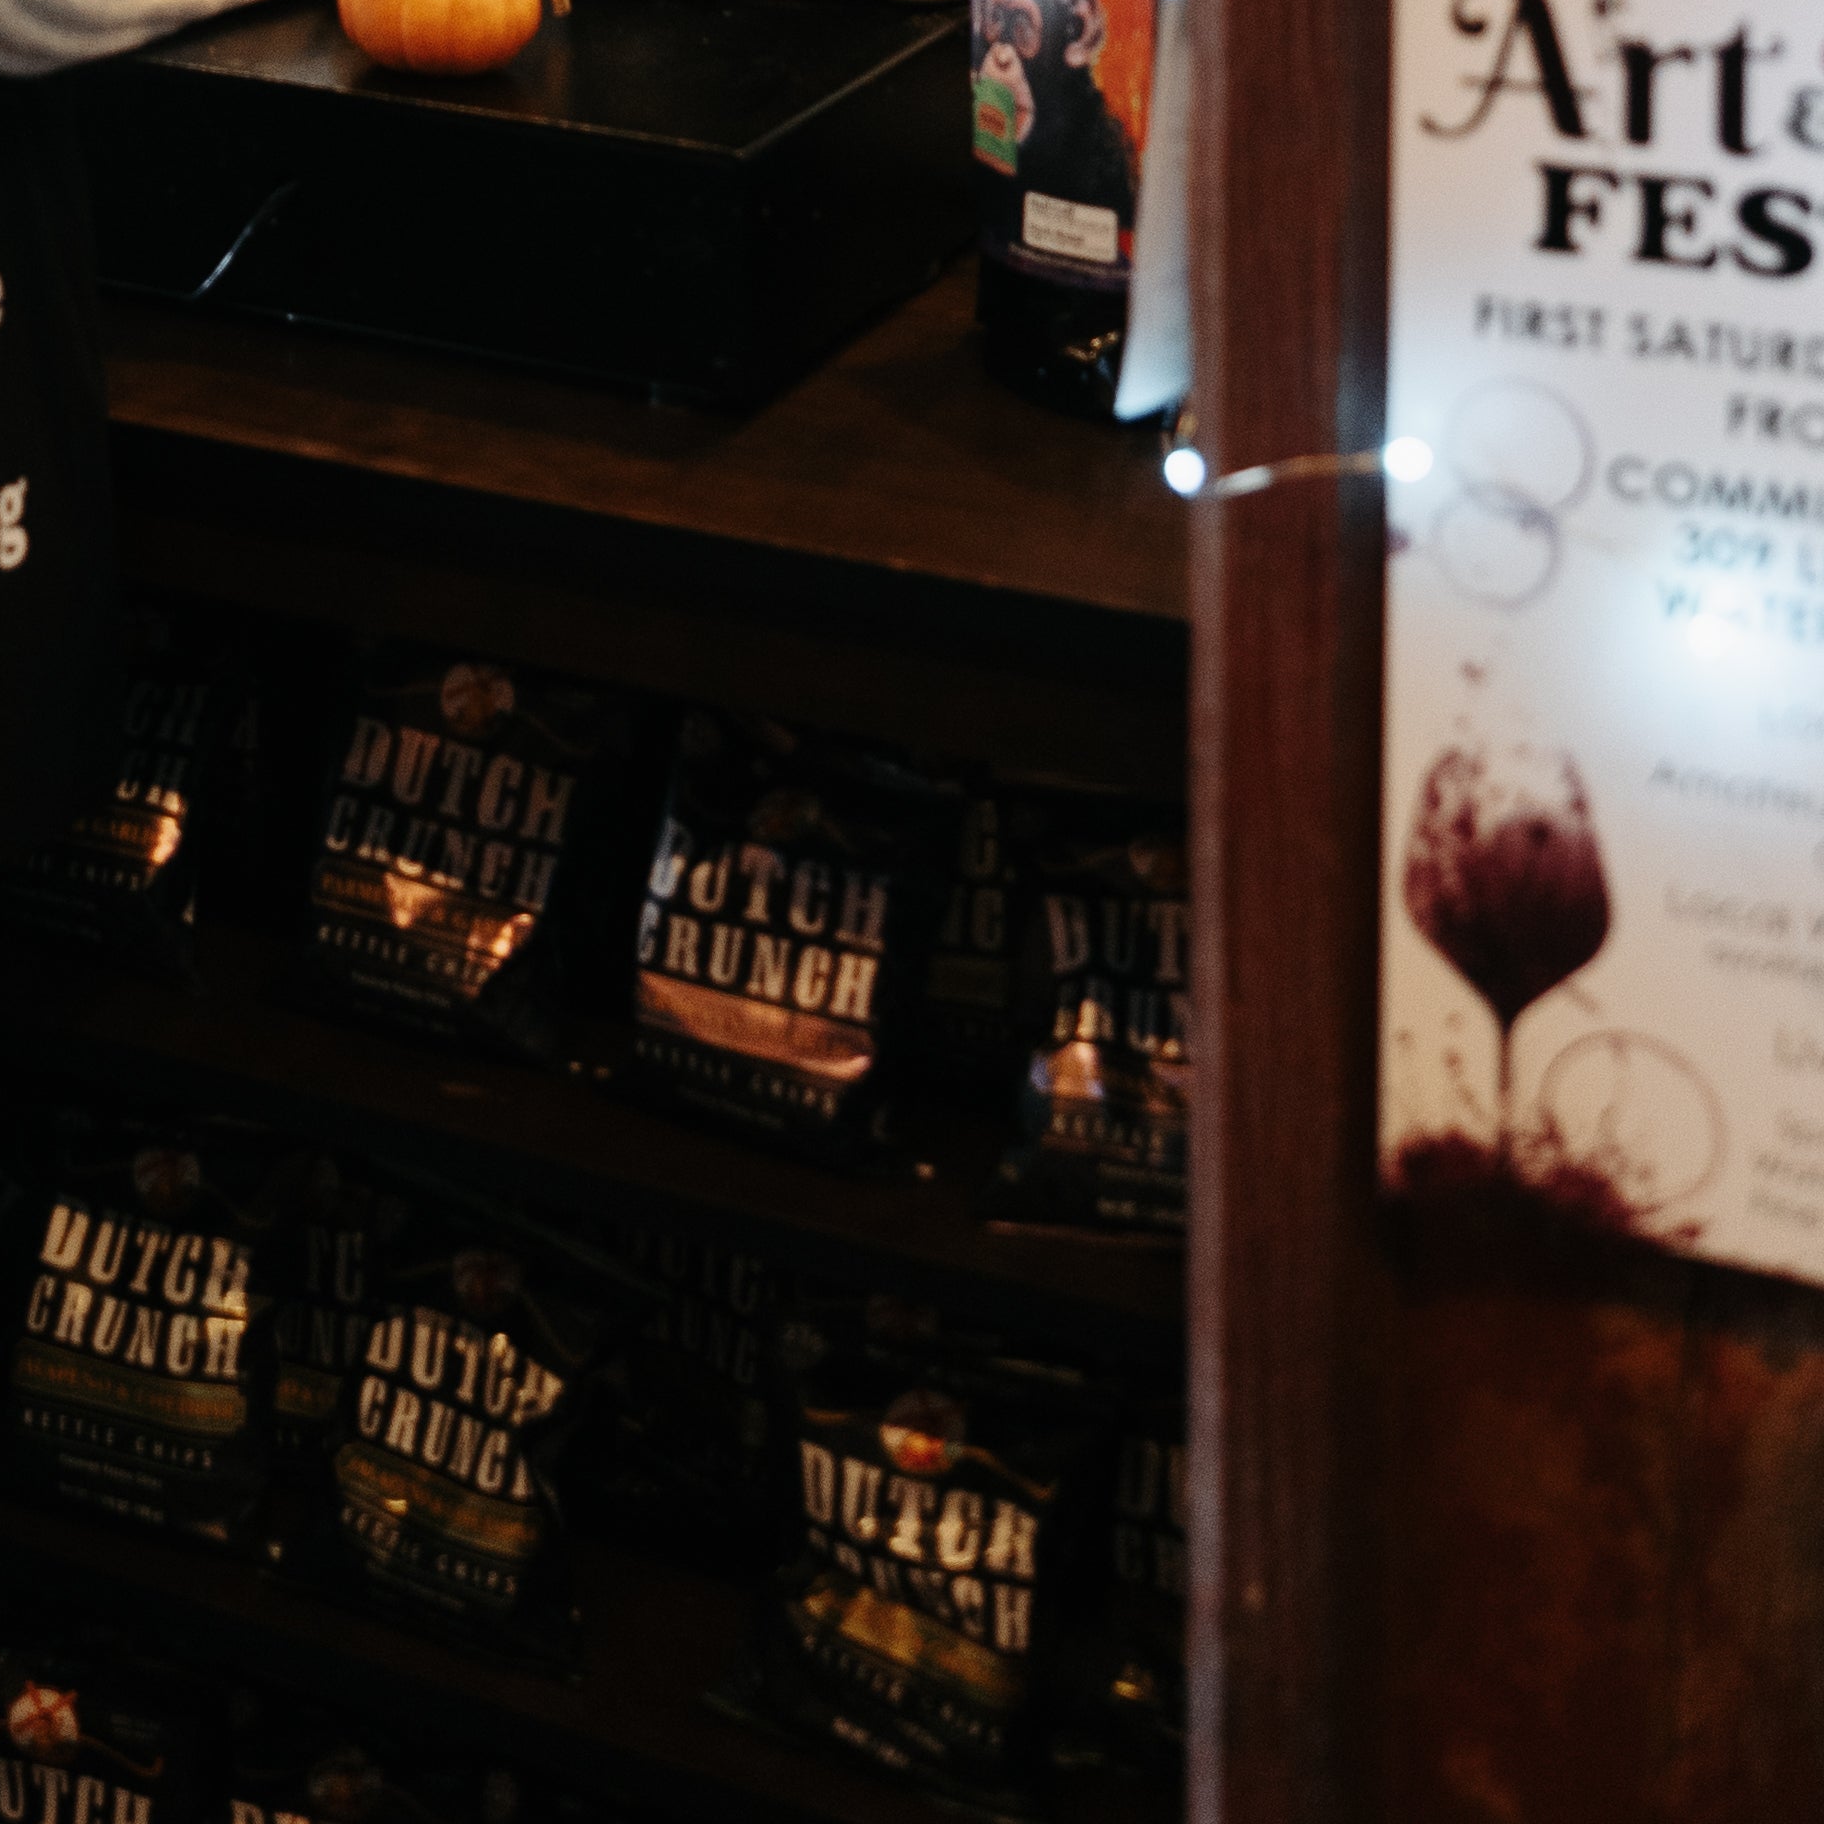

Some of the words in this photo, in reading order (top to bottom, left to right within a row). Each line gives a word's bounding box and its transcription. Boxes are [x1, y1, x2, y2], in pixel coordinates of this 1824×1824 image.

[1529, 158, 1824, 279] FES
[1473, 291, 1607, 351] FIRST
[1627, 310, 1824, 380] SATURD
[1726, 392, 1824, 451] FRO
[1604, 454, 1824, 524] COMM
[340, 715, 577, 846] DUTCH
[324, 795, 559, 914] CRUNCH
[647, 815, 889, 954] DUTCH
[635, 900, 879, 1021] CRUNCH
[1043, 891, 1183, 986] DUT
[37, 1201, 252, 1319] DUTCH
[25, 1273, 248, 1381] CRUNCH
[365, 1305, 567, 1429] DUTCH
[798, 1438, 1040, 1586] DUTCH
